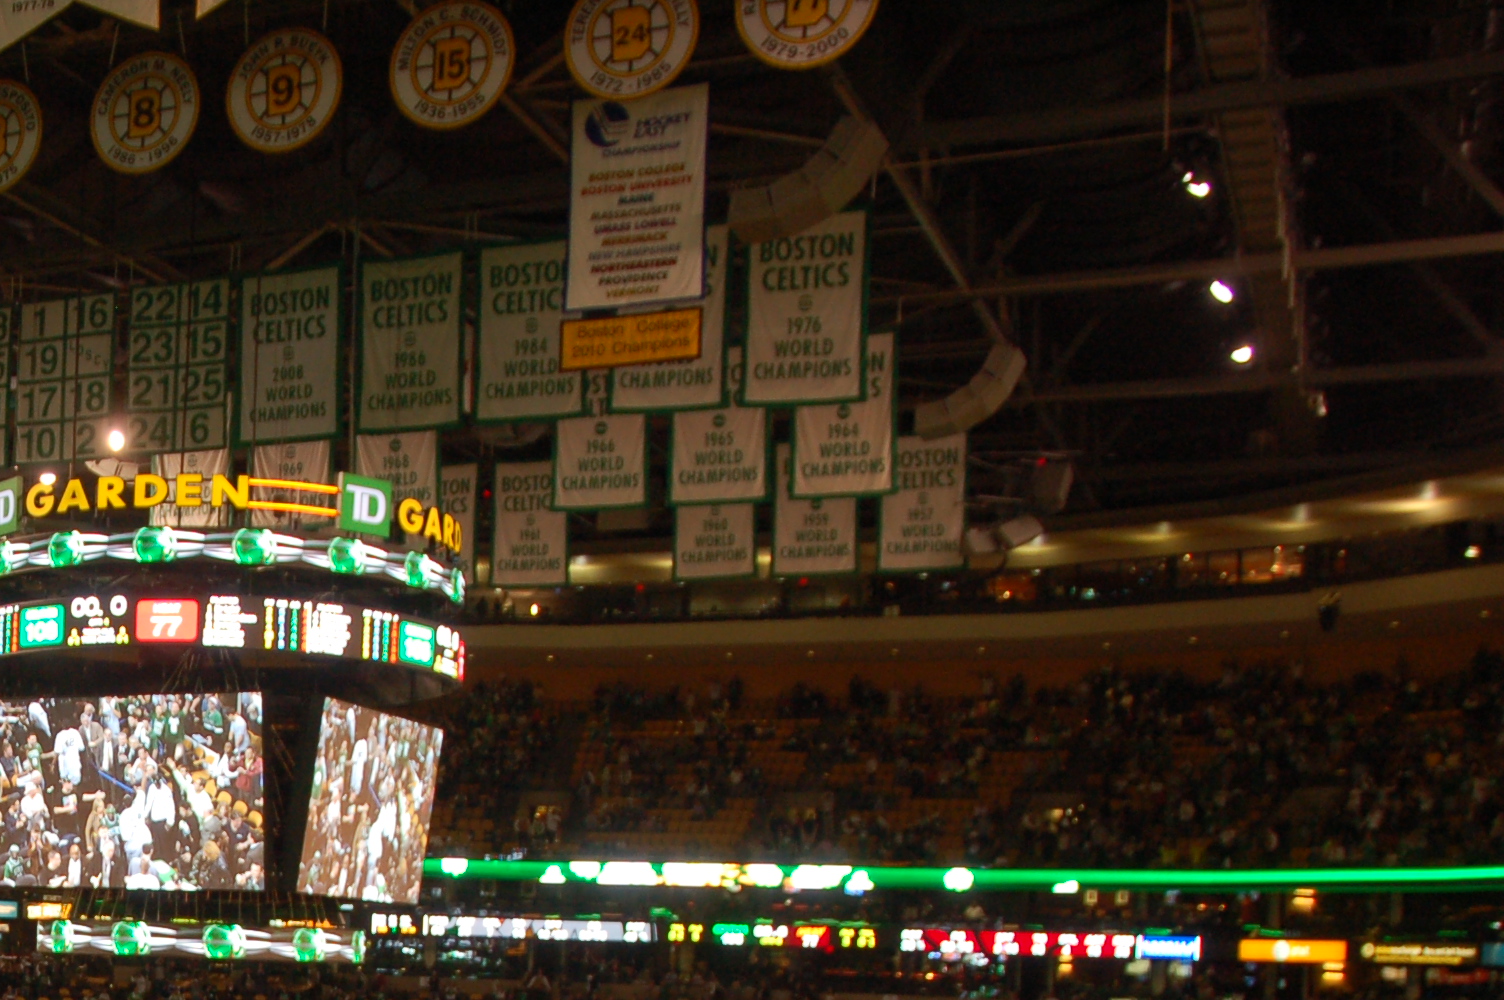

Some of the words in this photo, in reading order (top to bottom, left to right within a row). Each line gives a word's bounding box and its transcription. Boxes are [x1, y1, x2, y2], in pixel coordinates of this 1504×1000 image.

[616, 22, 647, 46] 24
[438, 49, 465, 79] 15
[98, 60, 149, 116] CAMERON
[169, 65, 194, 106] NEELY
[273, 75, 294, 106] 9
[134, 99, 155, 129] 8
[760, 231, 856, 263] BOSTON
[489, 258, 567, 288] BOSTO
[761, 262, 851, 292] CELTICS
[369, 271, 453, 302] BOSTON
[134, 291, 175, 322] 22
[250, 286, 330, 317] BOSTON
[34, 307, 45, 336] 1
[372, 300, 448, 329] CELTICS
[786, 316, 823, 335] 1976
[253, 314, 326, 345] CELTICS
[577, 322, 624, 340] Boston
[637, 317, 689, 336] College
[133, 331, 173, 363] 23
[514, 337, 547, 354] 1984
[612, 336, 690, 357] Champions
[773, 337, 835, 358] WORLD
[25, 344, 58, 377] 19
[394, 351, 427, 368] 1986
[503, 357, 557, 378] WORLD
[753, 358, 852, 381] CHAMPIONS
[182, 368, 222, 401] 25
[384, 369, 437, 390] WORLD
[484, 374, 575, 400] CHAMPIONS
[619, 366, 714, 389] CHAMPIONS
[133, 375, 170, 406] 21
[265, 383, 313, 403] WORLD
[367, 388, 453, 412] CHAMPIONS
[23, 387, 56, 418] 17
[249, 401, 327, 424] CHAMPIONS
[190, 413, 210, 444] 6
[704, 431, 734, 447] 1965
[21, 428, 56, 459] 10
[820, 440, 871, 458] WORLD
[577, 456, 625, 472] WORLD
[695, 449, 744, 466] WORLD
[802, 457, 886, 479] CHAMPIONS
[899, 447, 959, 468] OSTON
[562, 472, 640, 491] CHAMPIONS
[679, 466, 758, 486] CHAMPIONS
[25, 473, 250, 518] GARDEN
[346, 484, 386, 525] TD
[695, 533, 736, 547] WORLD
[795, 529, 839, 543] WORLD
[901, 524, 945, 538] WORLD
[511, 543, 550, 557] WORLD
[680, 548, 748, 563] CHAMPIONS
[780, 543, 850, 559] CHAMPIONS
[886, 538, 959, 555] CHAMPIONS
[497, 556, 561, 571] CHAMPIONS
[149, 615, 183, 637] 77
